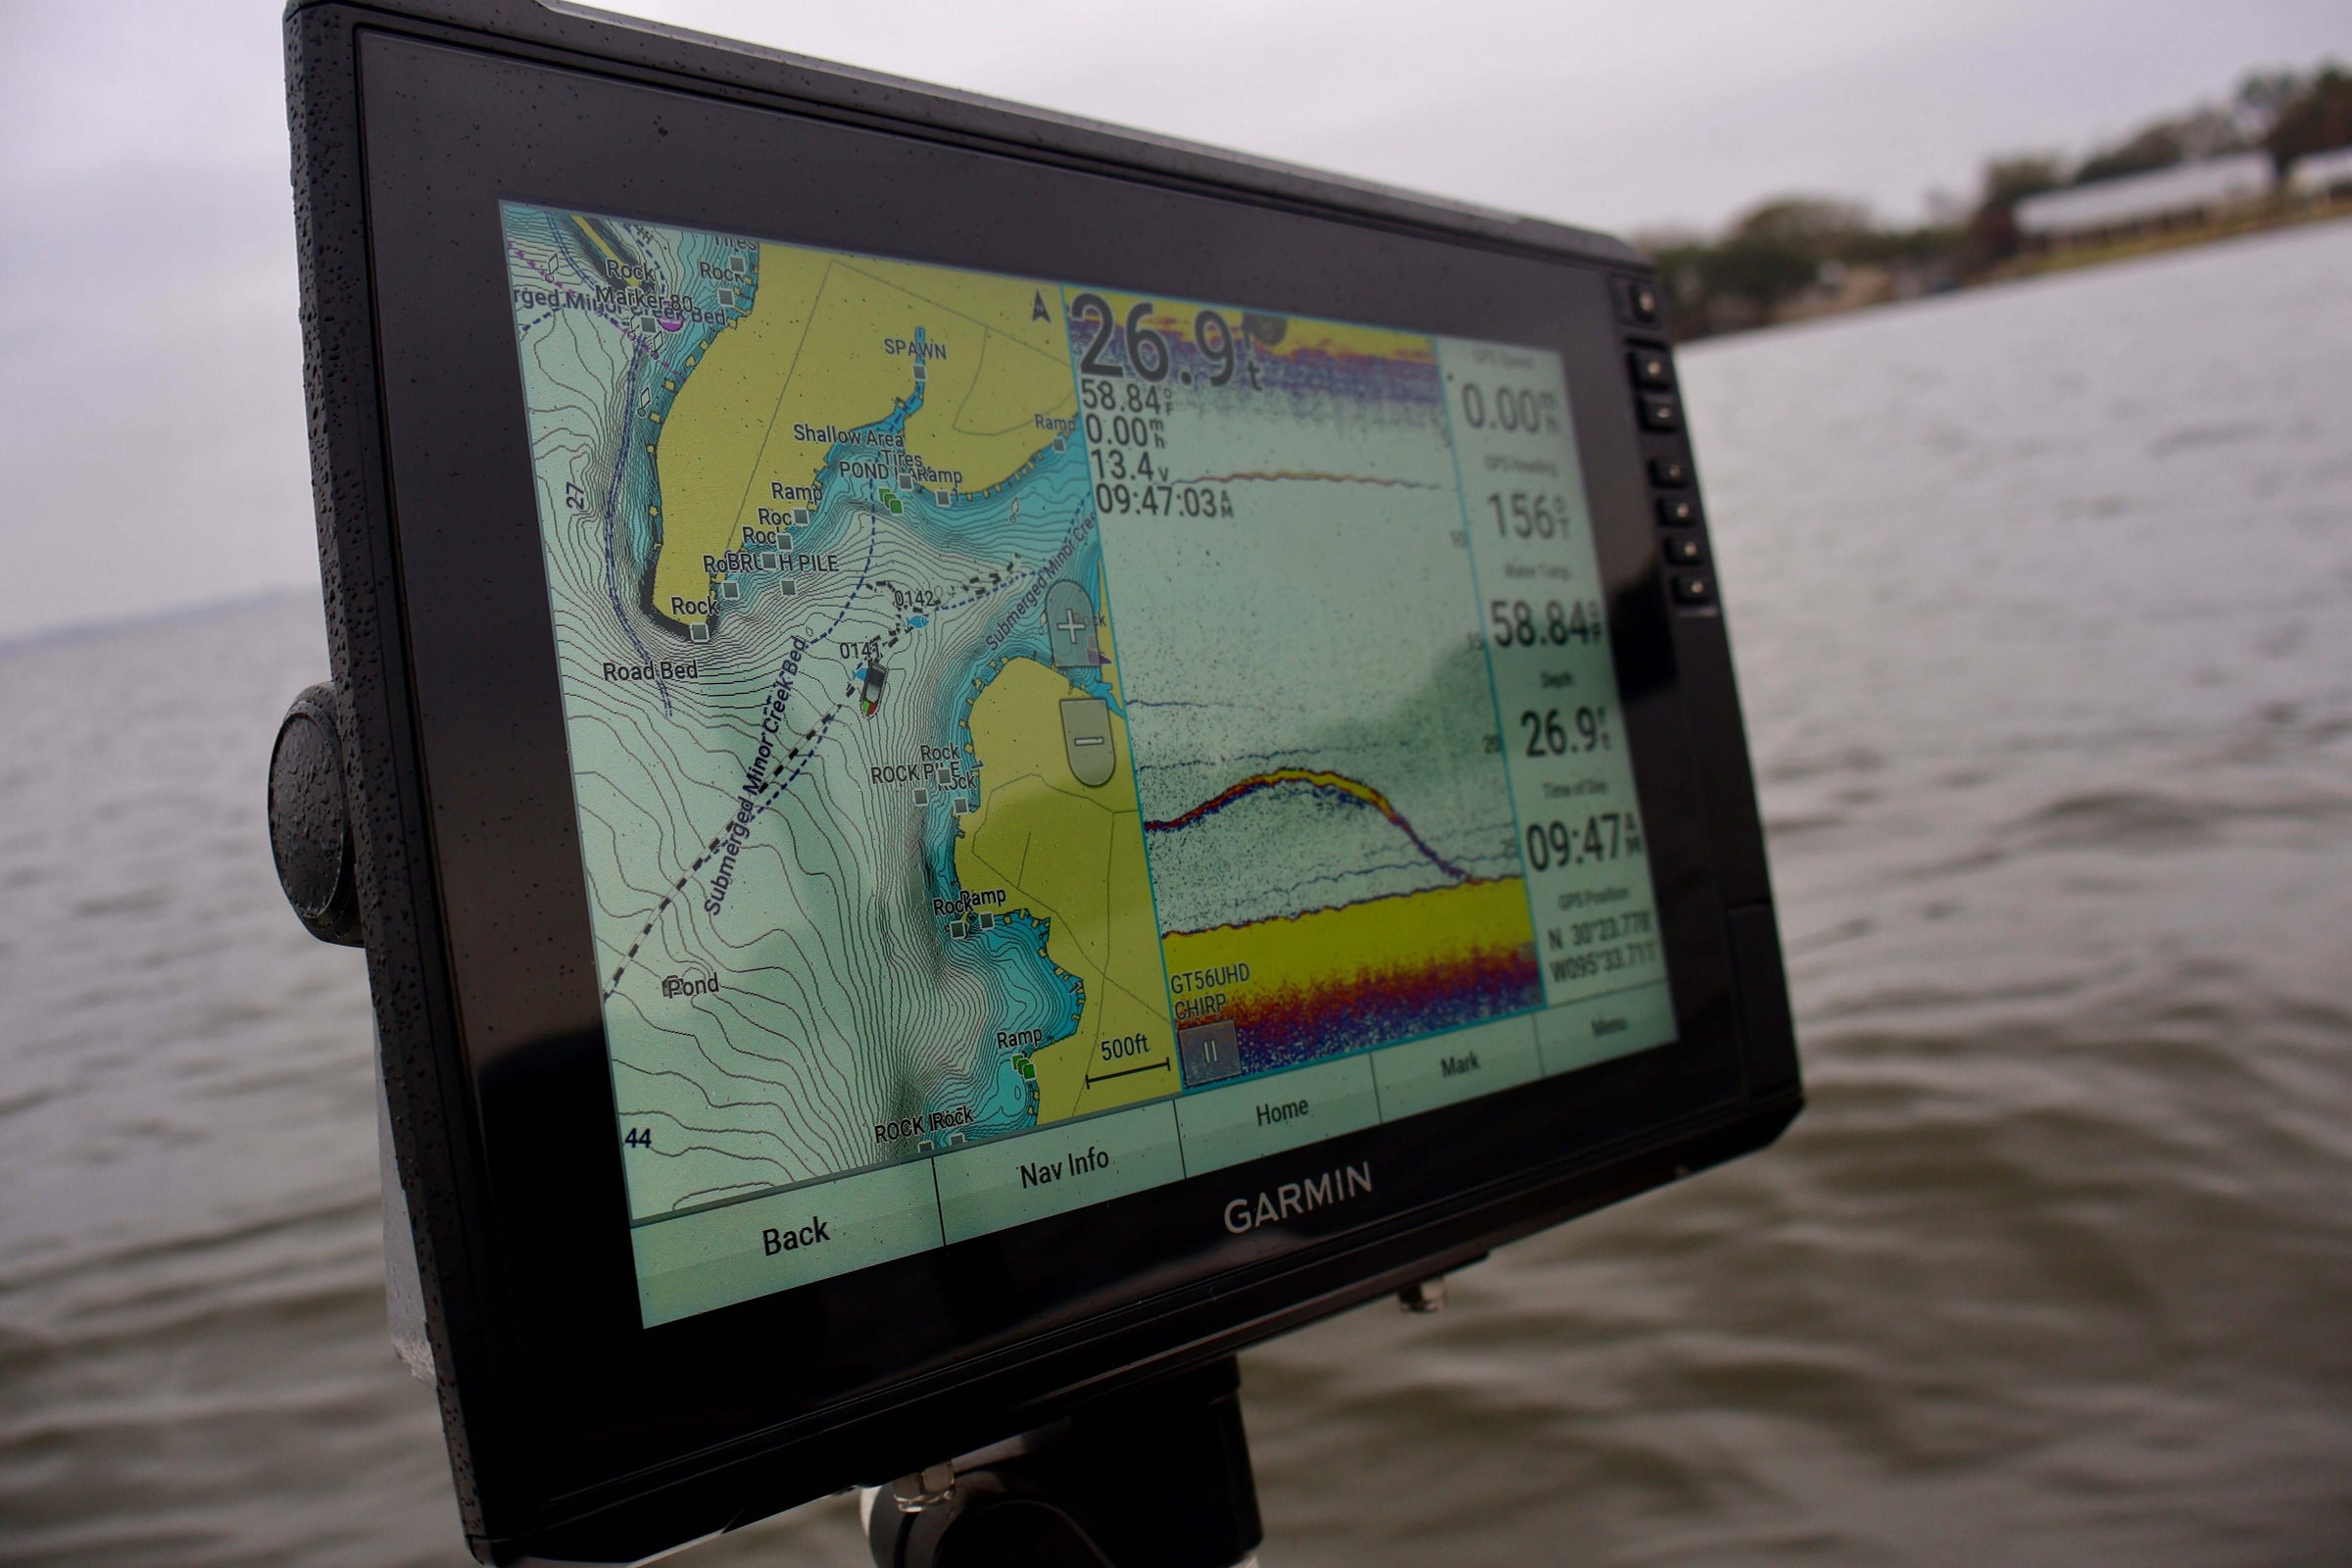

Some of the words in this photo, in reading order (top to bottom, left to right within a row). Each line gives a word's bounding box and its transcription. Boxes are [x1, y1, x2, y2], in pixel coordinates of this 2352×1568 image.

[607, 259, 655, 281] Rock
[595, 284, 665, 310] Marker
[884, 339, 948, 360] SPAWN
[1070, 293, 1235, 387] 26.9
[1081, 378, 1160, 415] 58.84
[1461, 382, 1540, 433] 0.00
[794, 424, 862, 446] Shallow
[866, 431, 905, 448] Area
[1035, 414, 1075, 434] Ramp
[1085, 414, 1148, 446] 0.00
[840, 462, 890, 479] POND
[881, 450, 923, 467] Tires
[1091, 449, 1153, 481] 13.4
[565, 481, 584, 510] 27
[771, 482, 822, 504] Ramp
[1096, 483, 1217, 516] 09:47:03
[759, 508, 795, 525] Roc
[1487, 493, 1555, 539] 156
[743, 526, 781, 544] Roc
[799, 555, 839, 572] PILE
[671, 596, 719, 615] Rock
[895, 590, 934, 607] 0142
[986, 570, 1049, 652] Submerged
[1043, 538, 1076, 581] Minor
[1490, 599, 1588, 649] 58.84
[604, 661, 655, 681] Road
[660, 660, 699, 679] Bed
[1520, 706, 1597, 759] 26.9
[920, 742, 960, 761] Rock
[704, 797, 754, 916] Submerged
[742, 729, 775, 799] Minor
[763, 676, 794, 734] Creek
[782, 634, 807, 676] Bed
[871, 764, 920, 784] ROCK
[1526, 814, 1620, 872] 09:47
[933, 894, 973, 915] Rock
[667, 972, 719, 999] Pond
[1170, 962, 1250, 995] GT56UHD
[1175, 993, 1228, 1021] CHIRP
[996, 1027, 1043, 1050] Ramp
[1102, 1033, 1151, 1061] 500ft
[1441, 1051, 1481, 1078] Mark
[1255, 1099, 1310, 1127] Home
[624, 1127, 652, 1149] 44
[874, 1116, 925, 1144] ROCK
[1019, 1161, 1063, 1189] Nav
[1067, 1146, 1109, 1177] Info
[1224, 1160, 1373, 1235] GARMIN
[762, 1215, 831, 1256] Back
